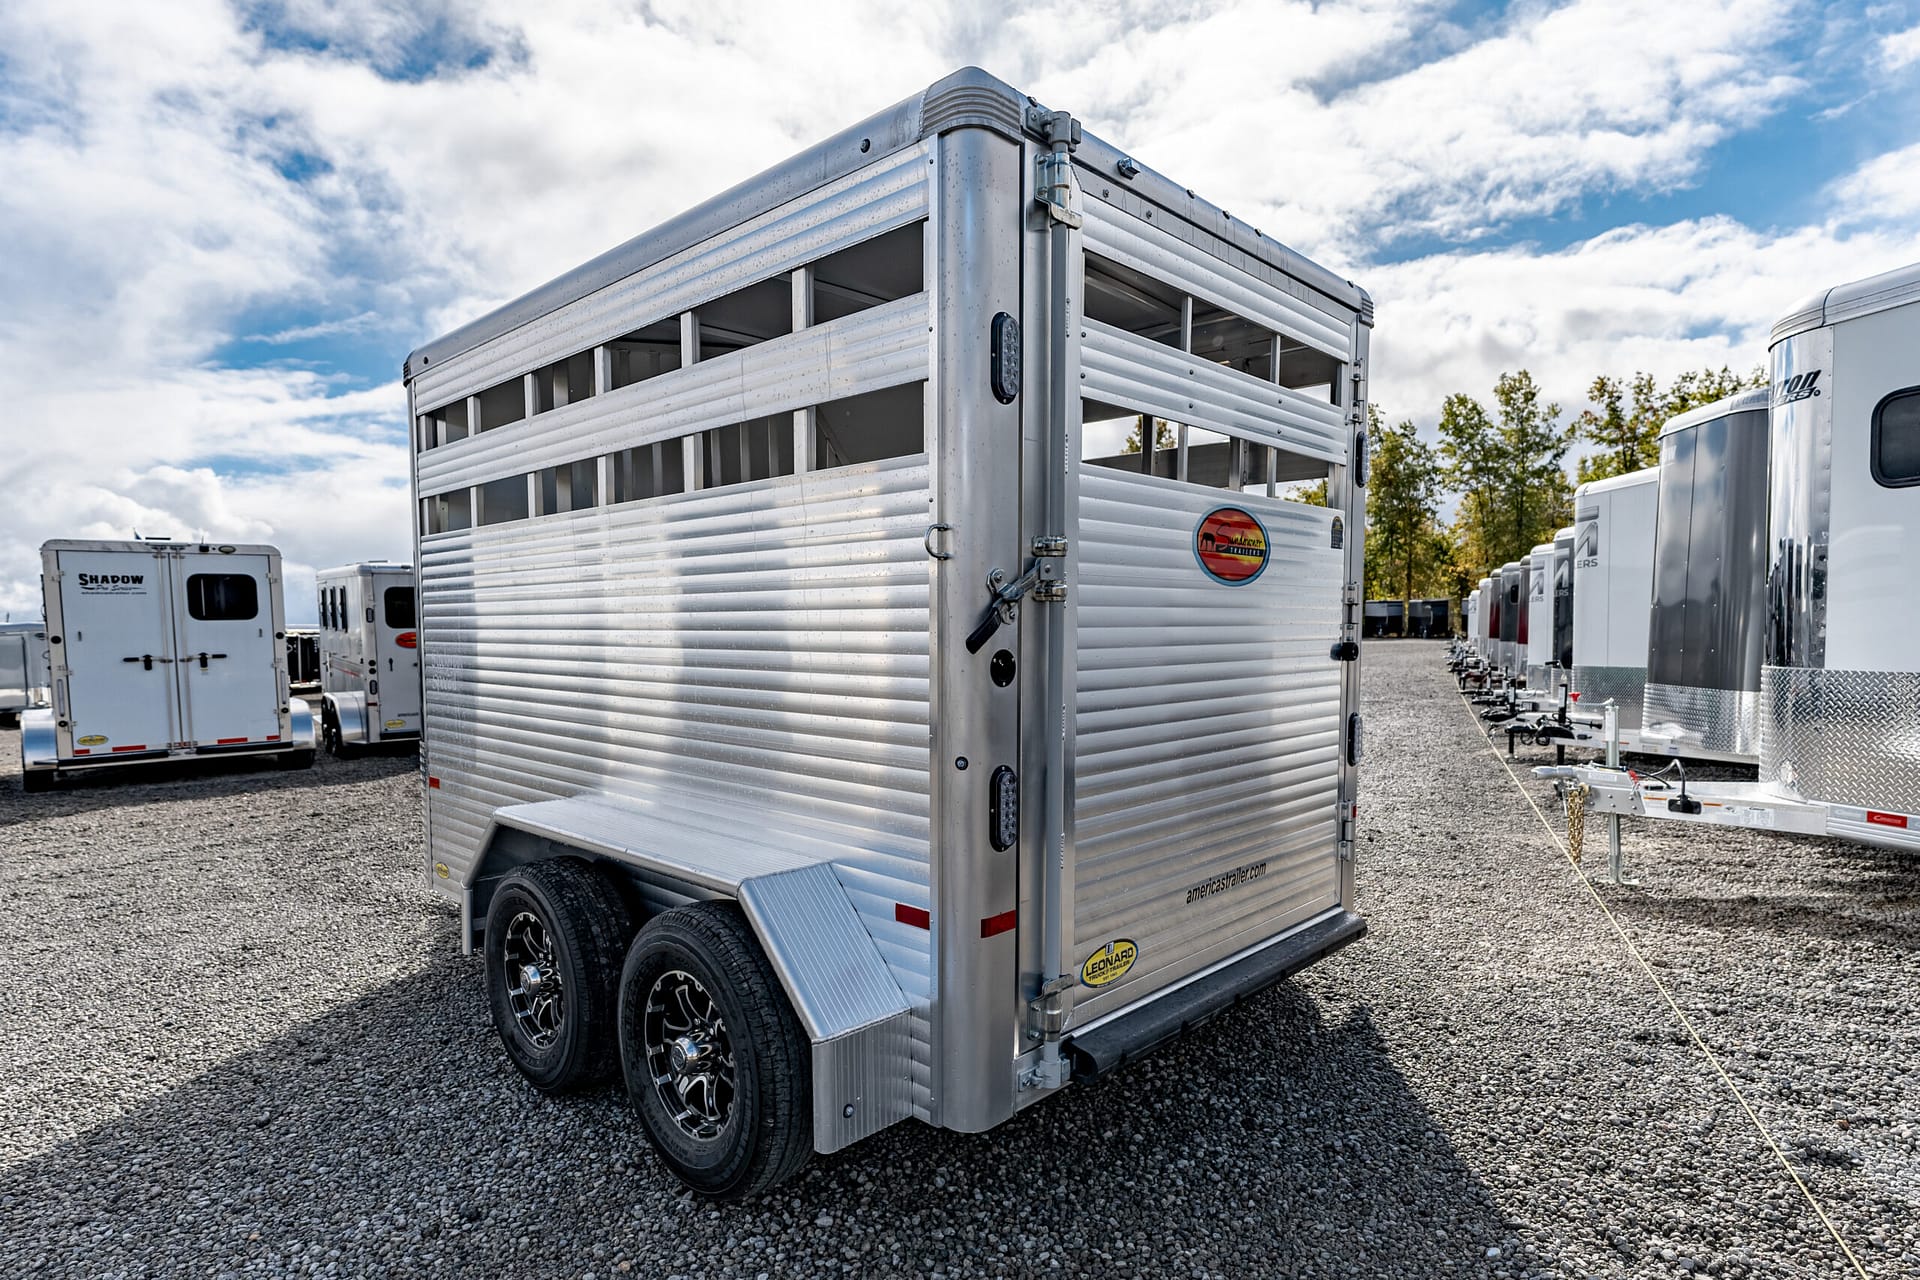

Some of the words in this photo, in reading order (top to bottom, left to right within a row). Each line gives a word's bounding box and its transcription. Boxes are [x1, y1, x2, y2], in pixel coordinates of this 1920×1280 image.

[78, 573, 144, 586] SHADOW
[1186, 862, 1267, 905] americastrailer.com
[1086, 946, 1134, 977] LEONARD
